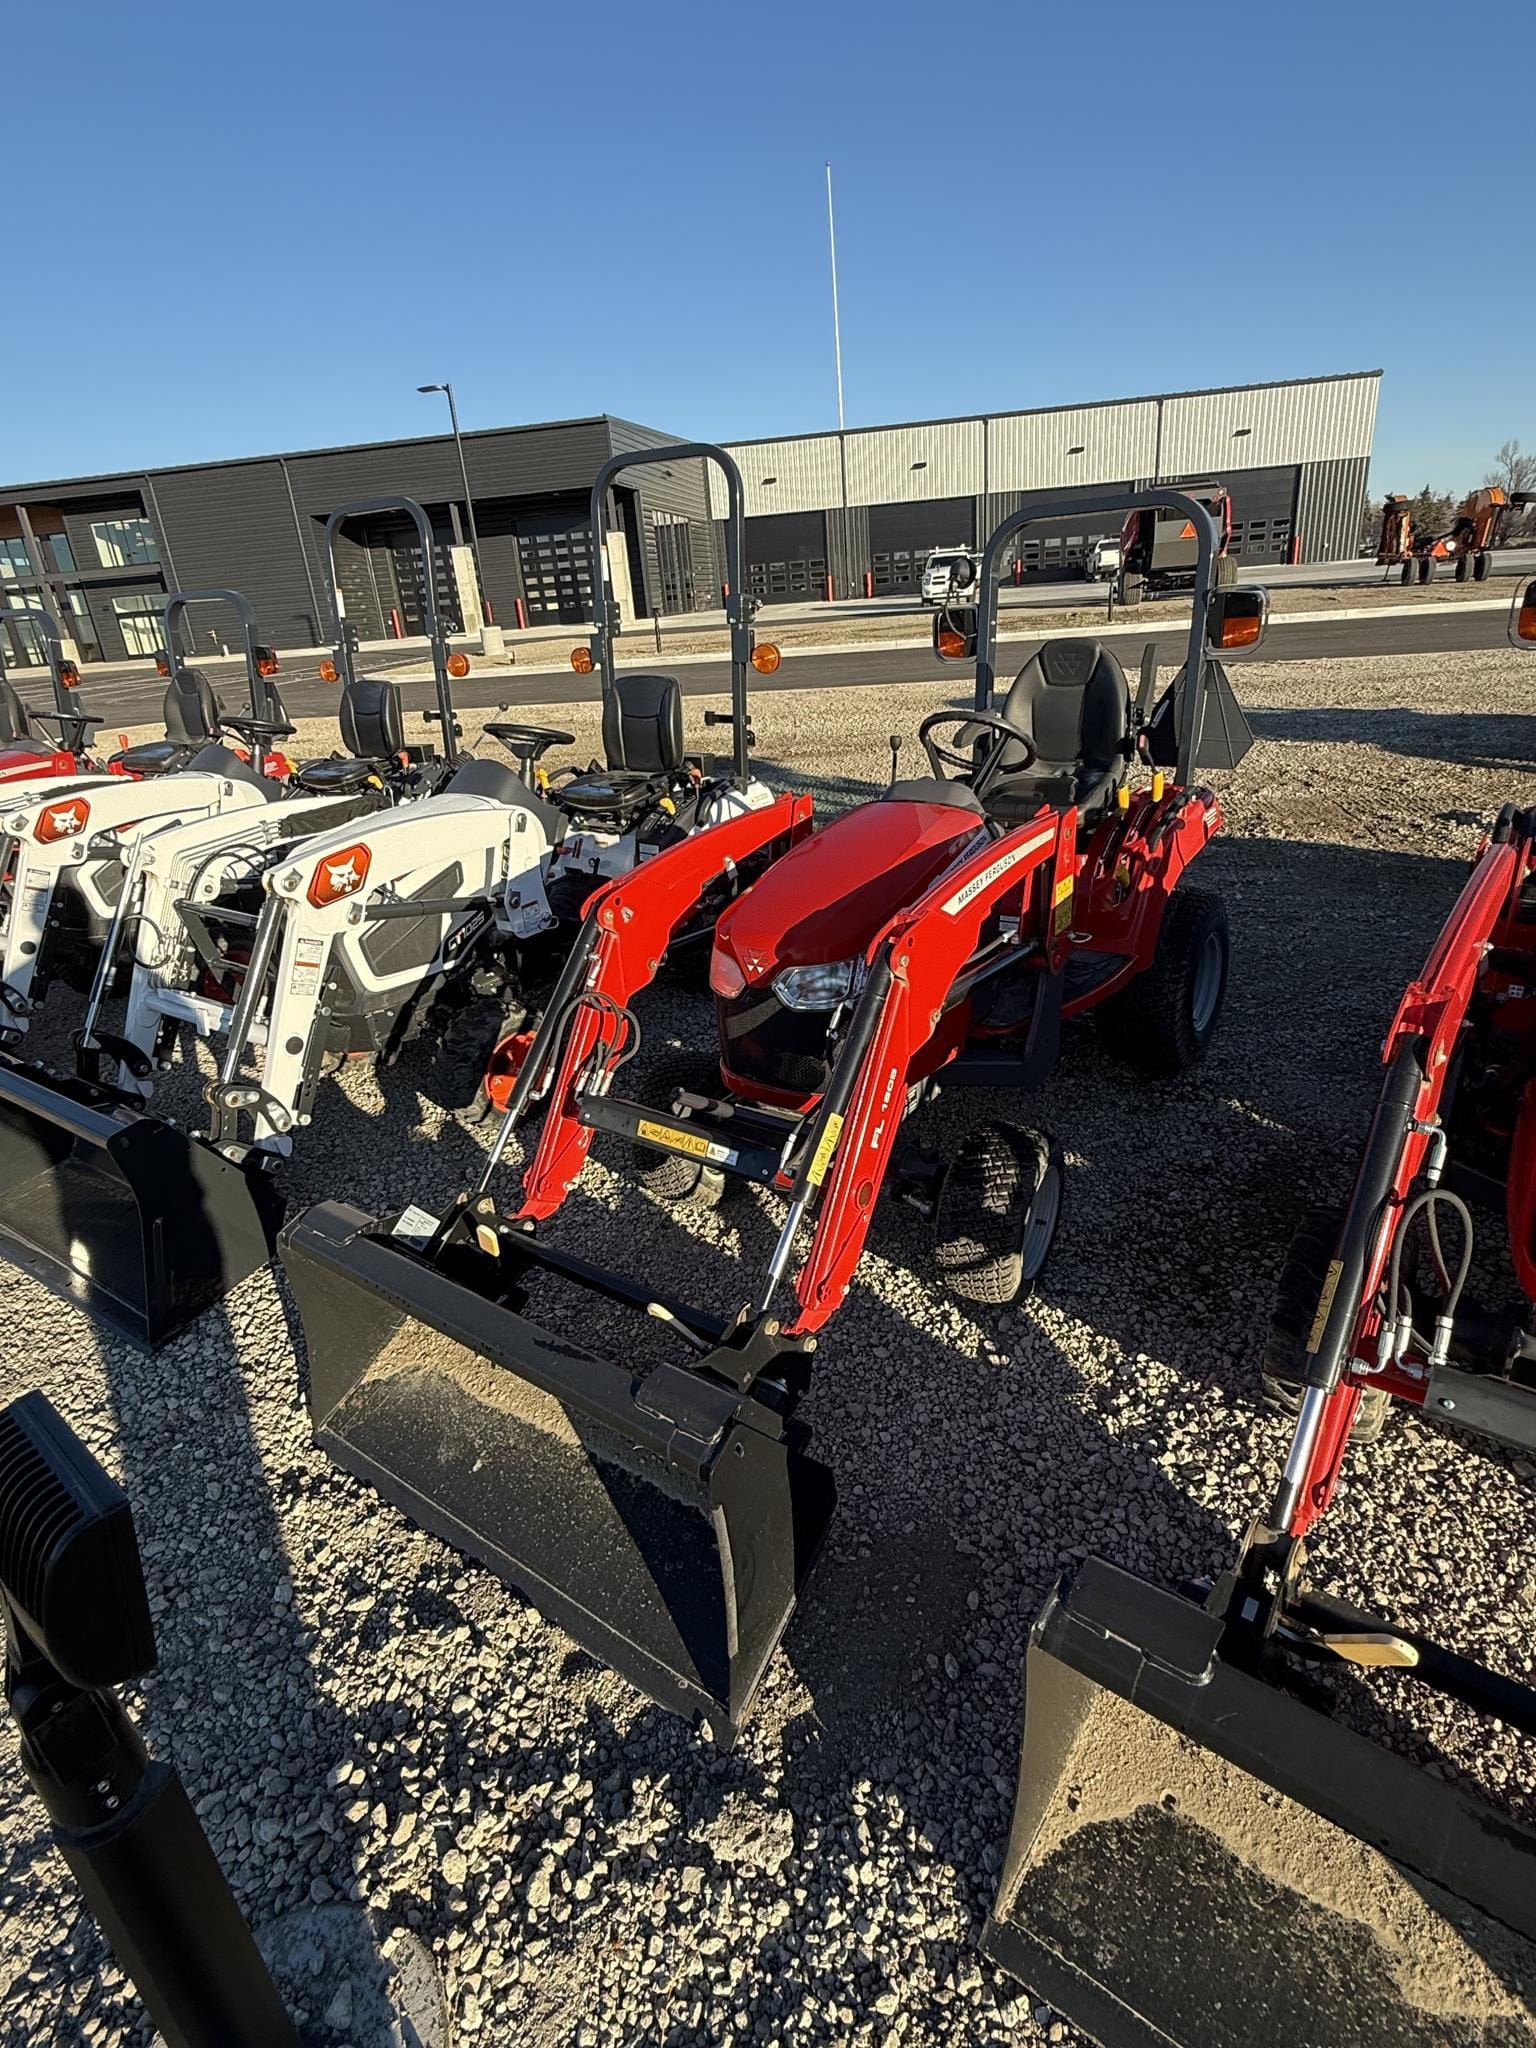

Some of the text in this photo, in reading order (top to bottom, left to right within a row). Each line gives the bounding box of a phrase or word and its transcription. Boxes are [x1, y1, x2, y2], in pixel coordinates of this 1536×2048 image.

[958, 877, 984, 905] MASSEY
[985, 853, 1016, 882] FERGUSON
[448, 911, 485, 951] CT1025
[871, 1119, 885, 1149] FL
